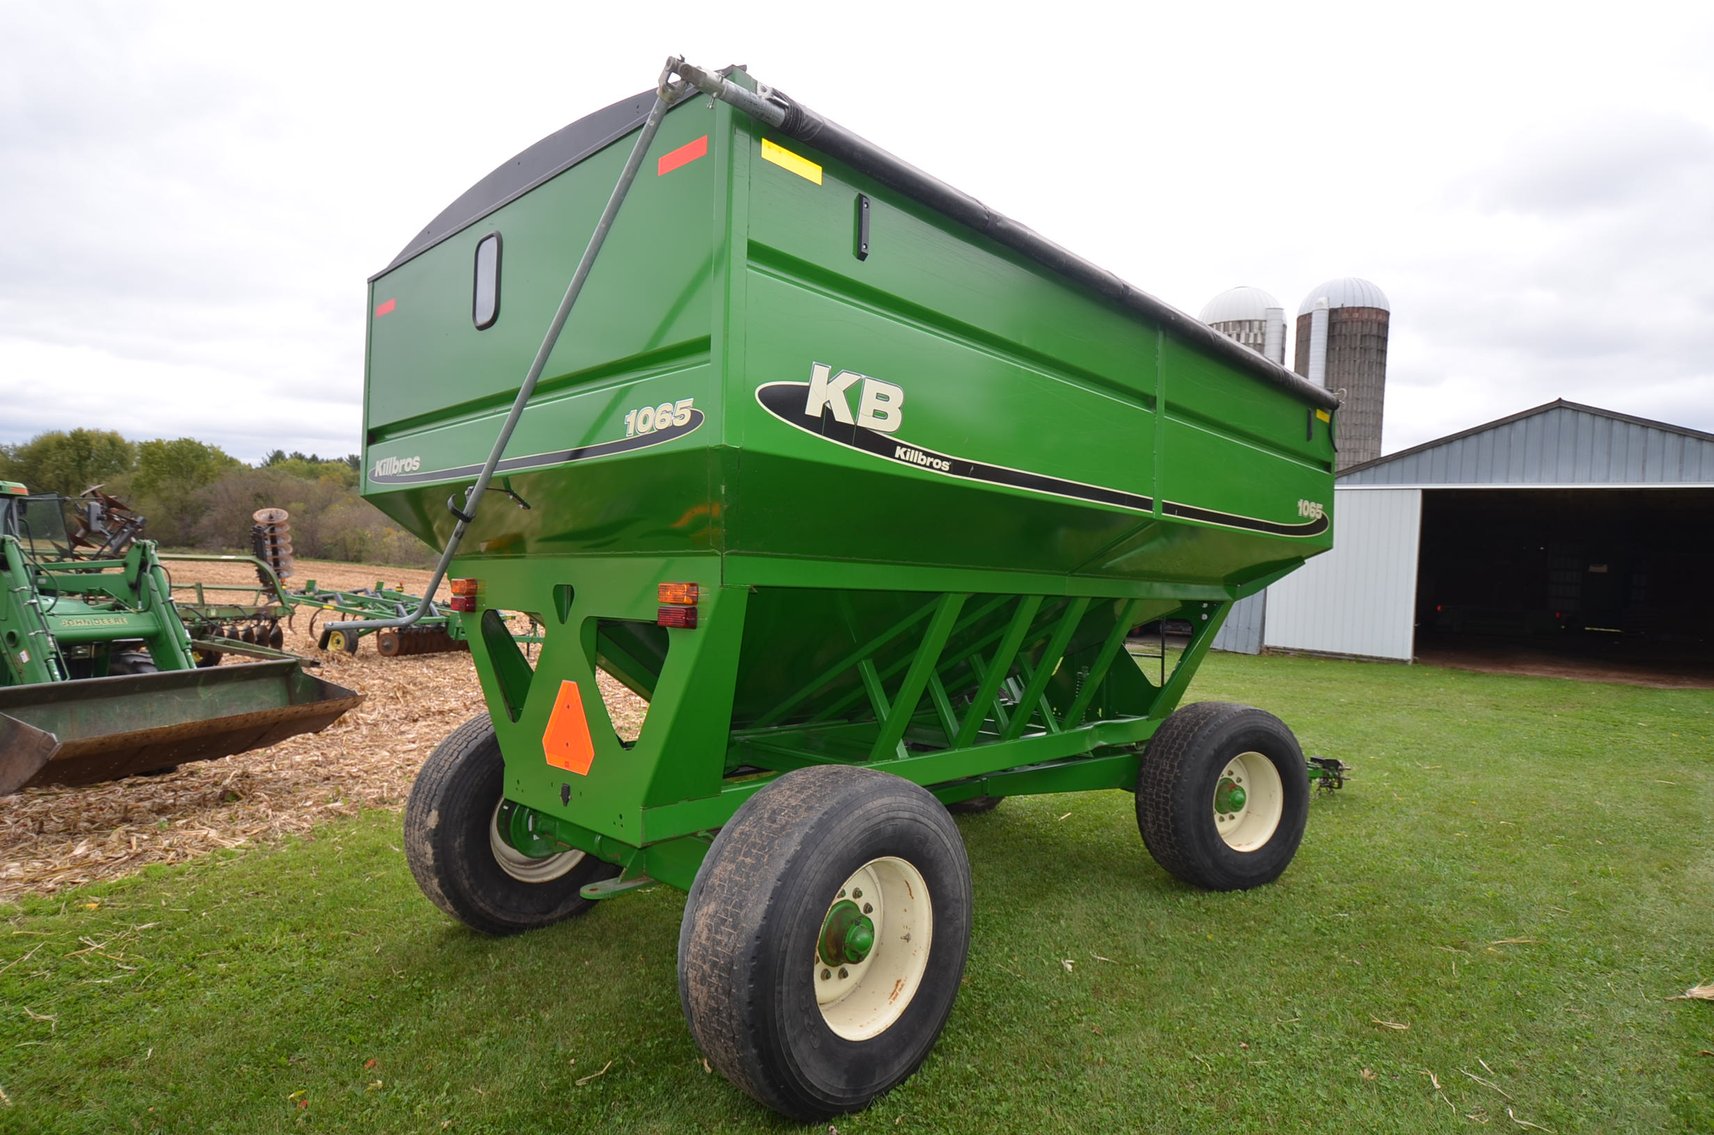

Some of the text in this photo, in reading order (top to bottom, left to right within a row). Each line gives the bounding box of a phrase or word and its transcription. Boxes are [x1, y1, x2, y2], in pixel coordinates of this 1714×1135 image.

[805, 361, 904, 433] KB
[624, 397, 694, 437] 1065
[374, 456, 421, 478] Killbros
[893, 445, 951, 472] Killbros
[1297, 498, 1324, 520] 1065
[62, 616, 129, 627] JOHN DEERE
